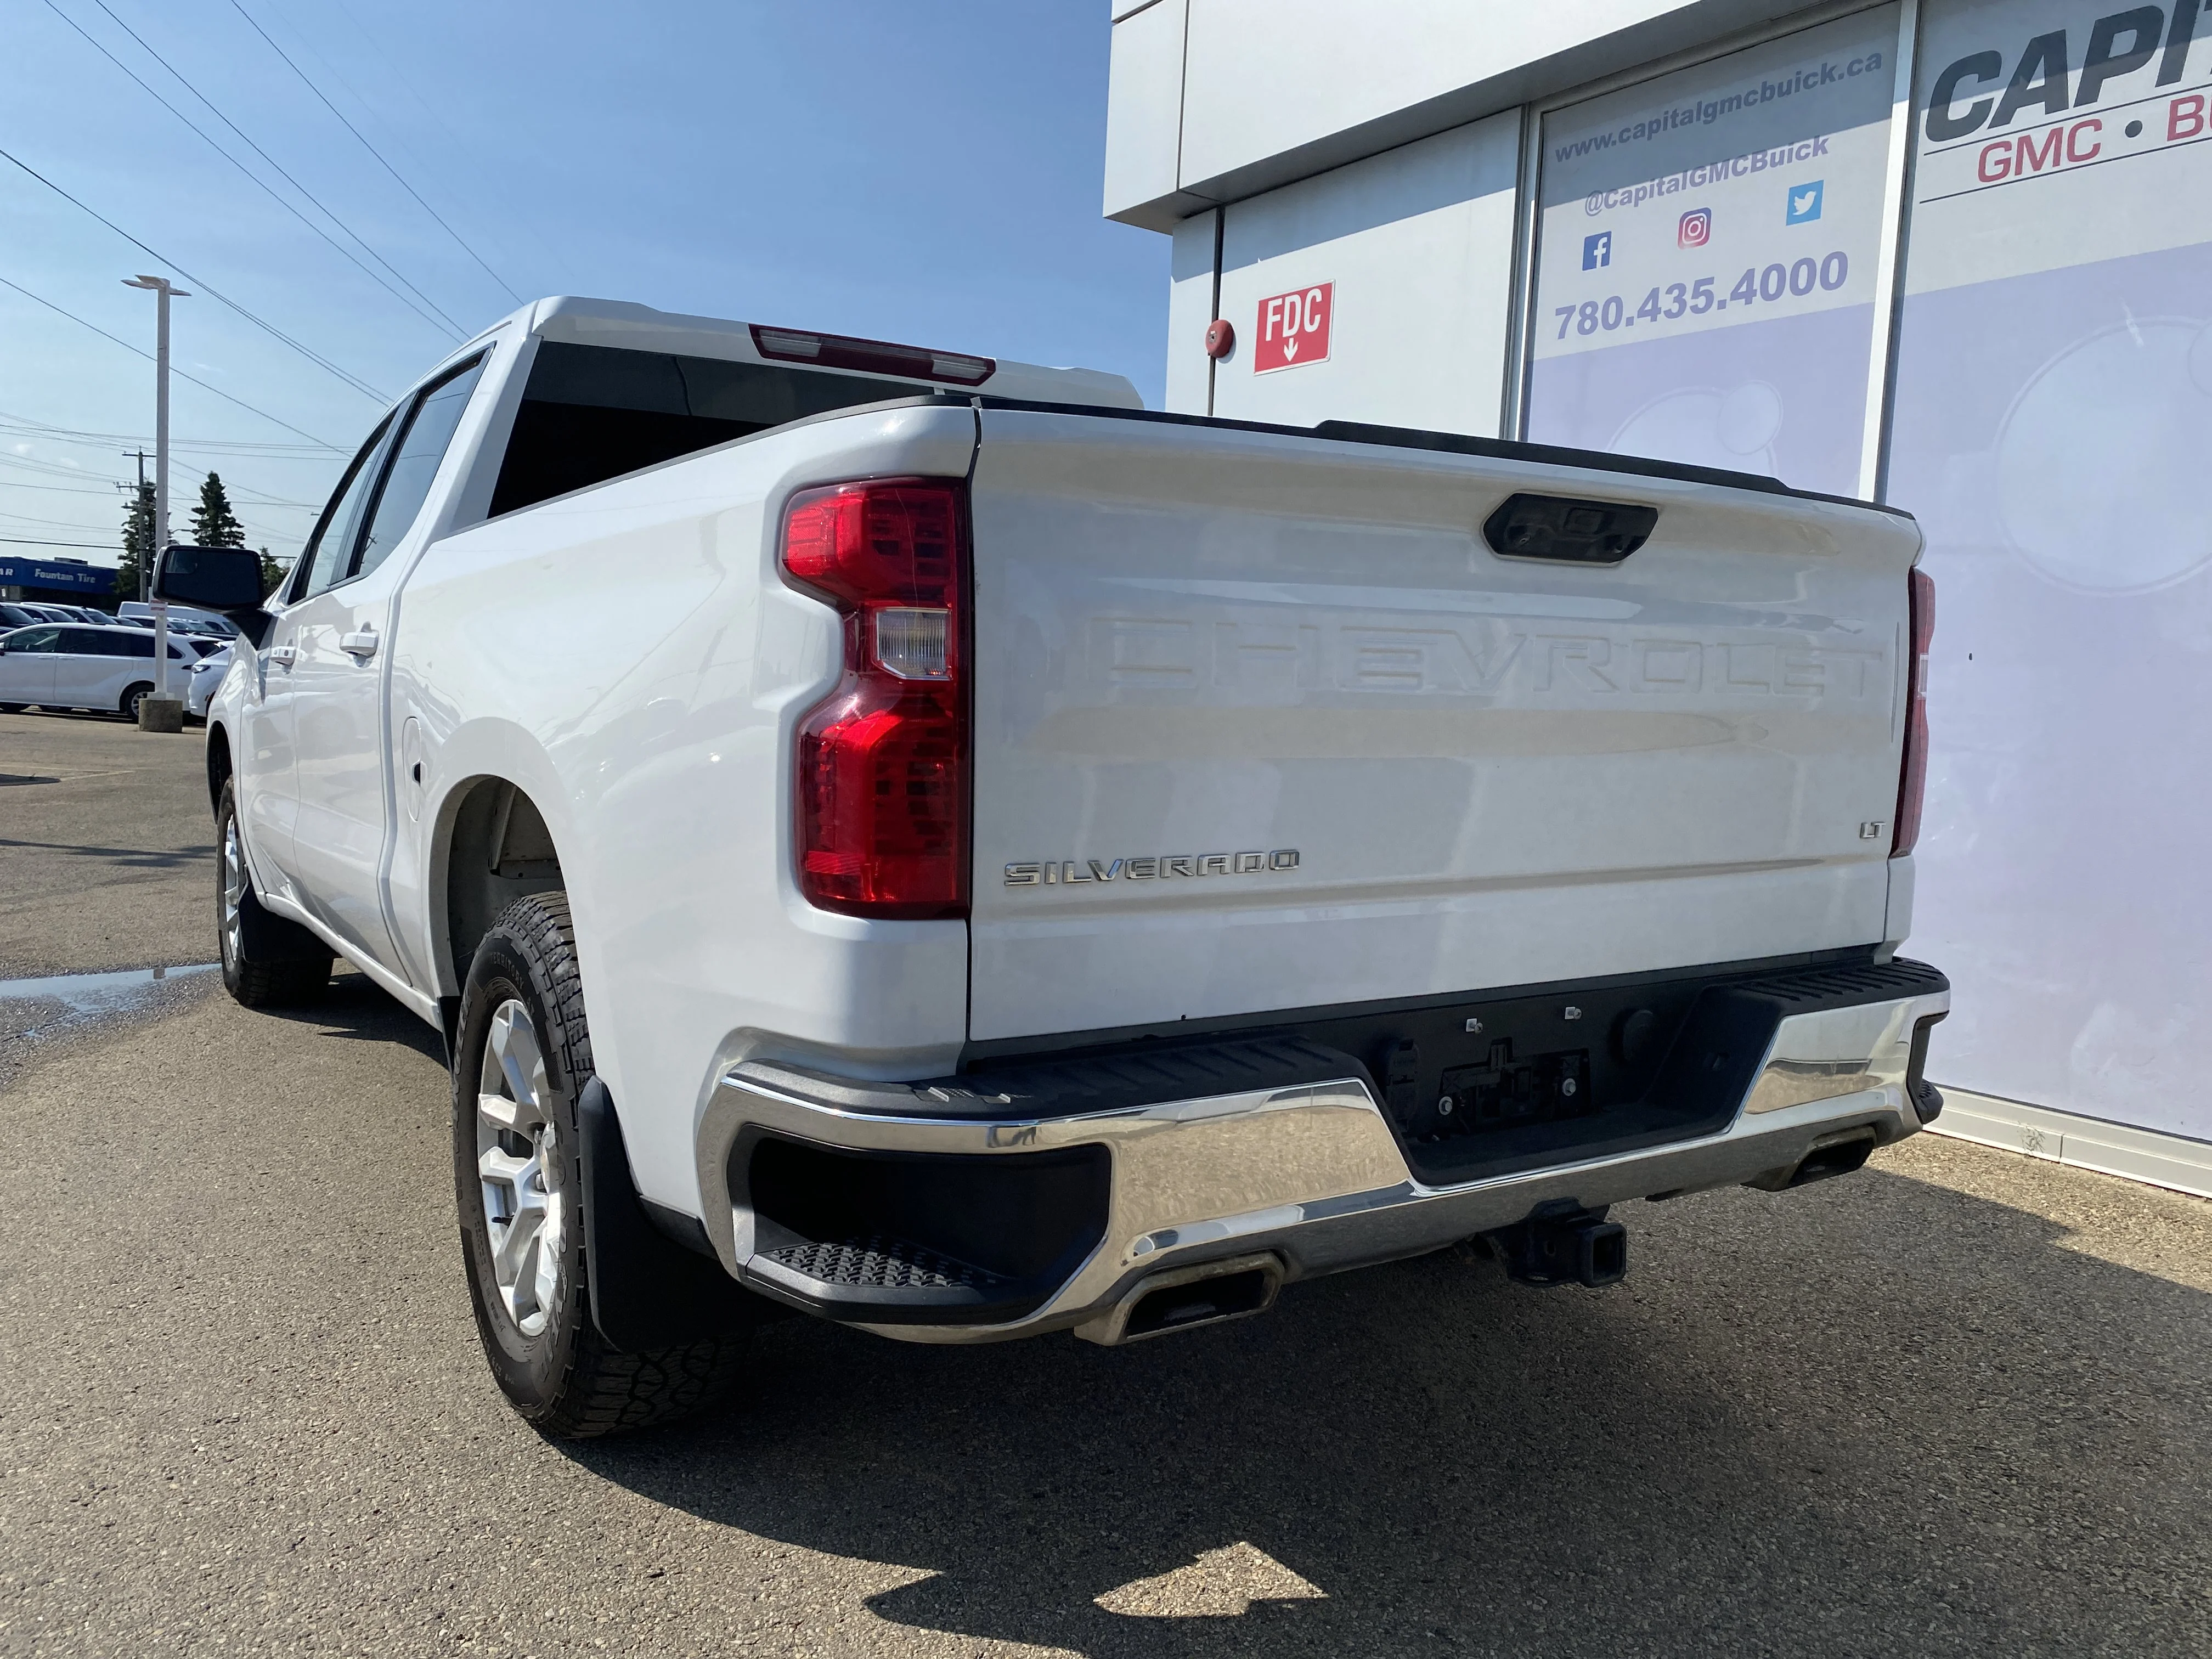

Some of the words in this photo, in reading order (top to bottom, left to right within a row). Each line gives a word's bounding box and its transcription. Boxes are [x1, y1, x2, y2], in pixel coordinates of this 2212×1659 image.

[1555, 53, 1882, 162] www.capitalgmcbuick.ca
[1926, 0, 2212, 142] CAPI
[1584, 134, 1829, 217] @CapitalGMCBuick
[1978, 119, 2102, 183] GMC
[2167, 94, 2212, 141] B
[1265, 288, 1323, 342] FDC
[1555, 251, 1849, 340] 780.435.4000
[35, 568, 74, 581] Fountain
[77, 573, 96, 583] Tire
[1085, 617, 1883, 701] CHEVROLET
[1004, 849, 1301, 886] SILVERADO
[1860, 821, 1887, 838] LT
